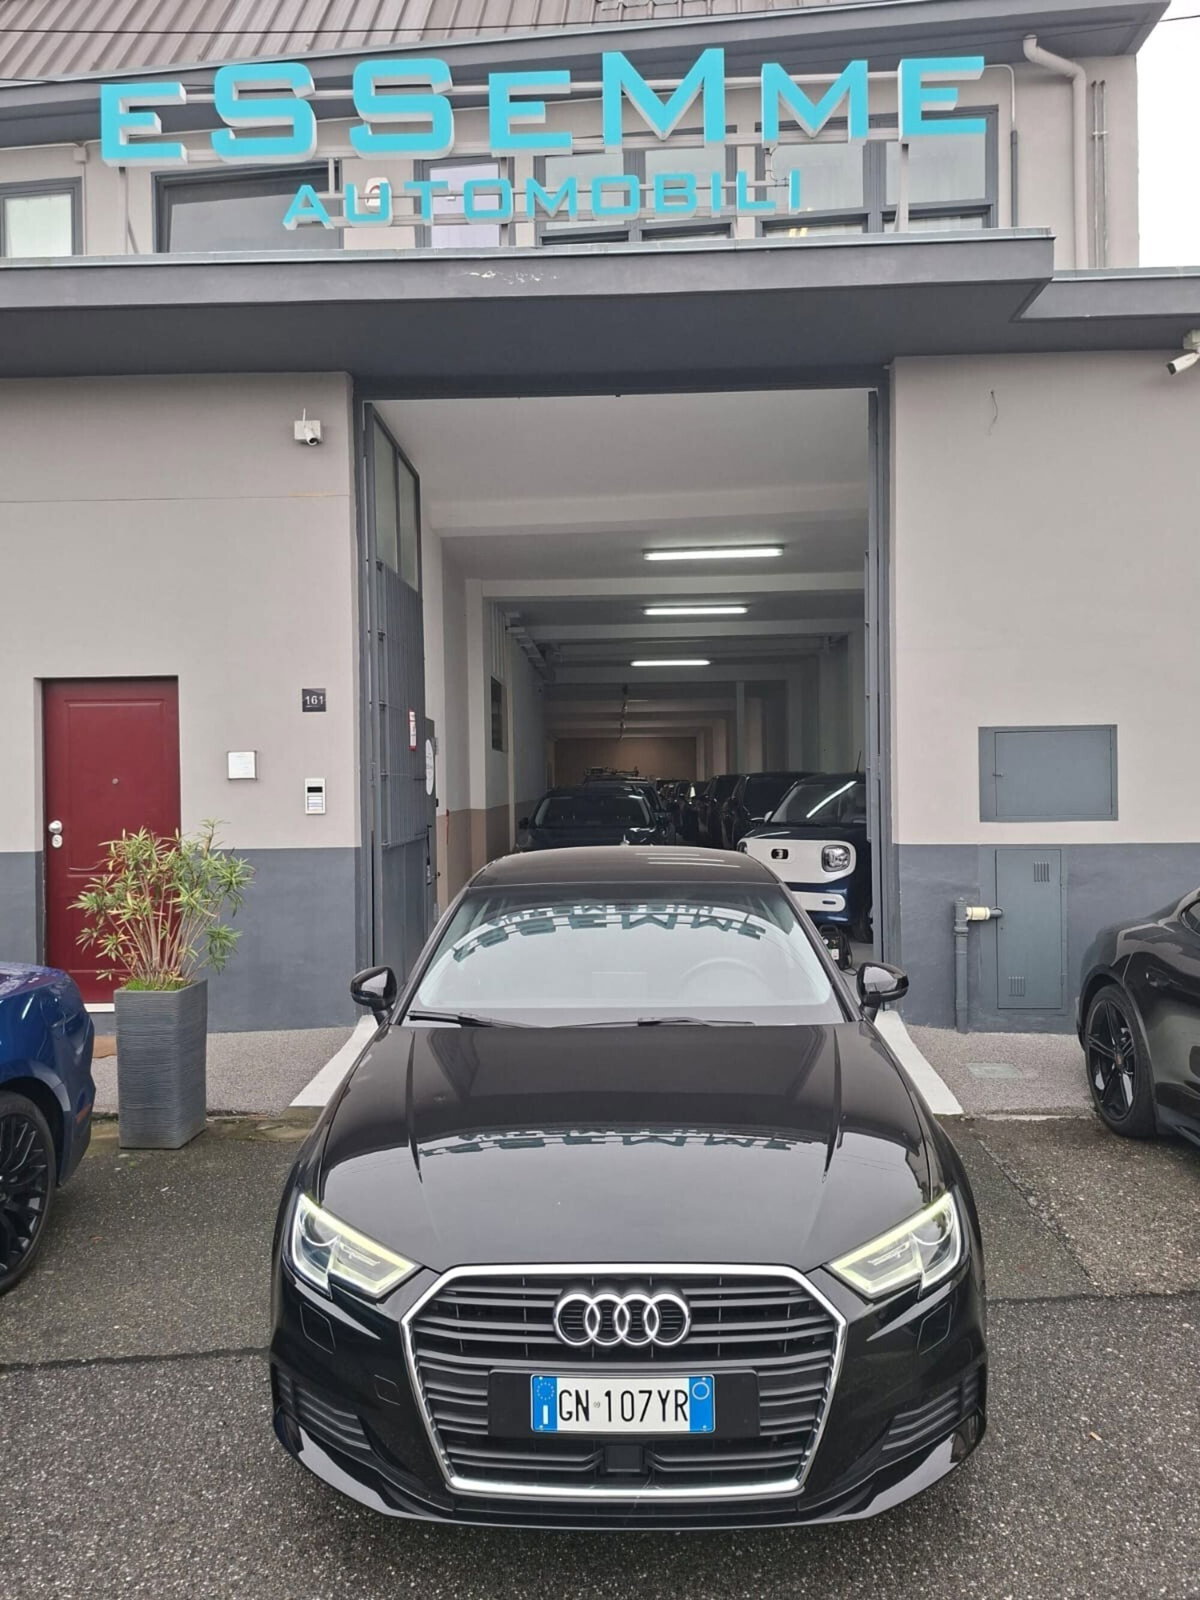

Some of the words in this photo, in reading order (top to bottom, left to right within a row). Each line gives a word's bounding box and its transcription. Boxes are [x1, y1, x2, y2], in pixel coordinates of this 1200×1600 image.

[98, 48, 989, 166] ESSEMME
[282, 169, 802, 229] AUTOMOBILI
[305, 695, 324, 705] 161
